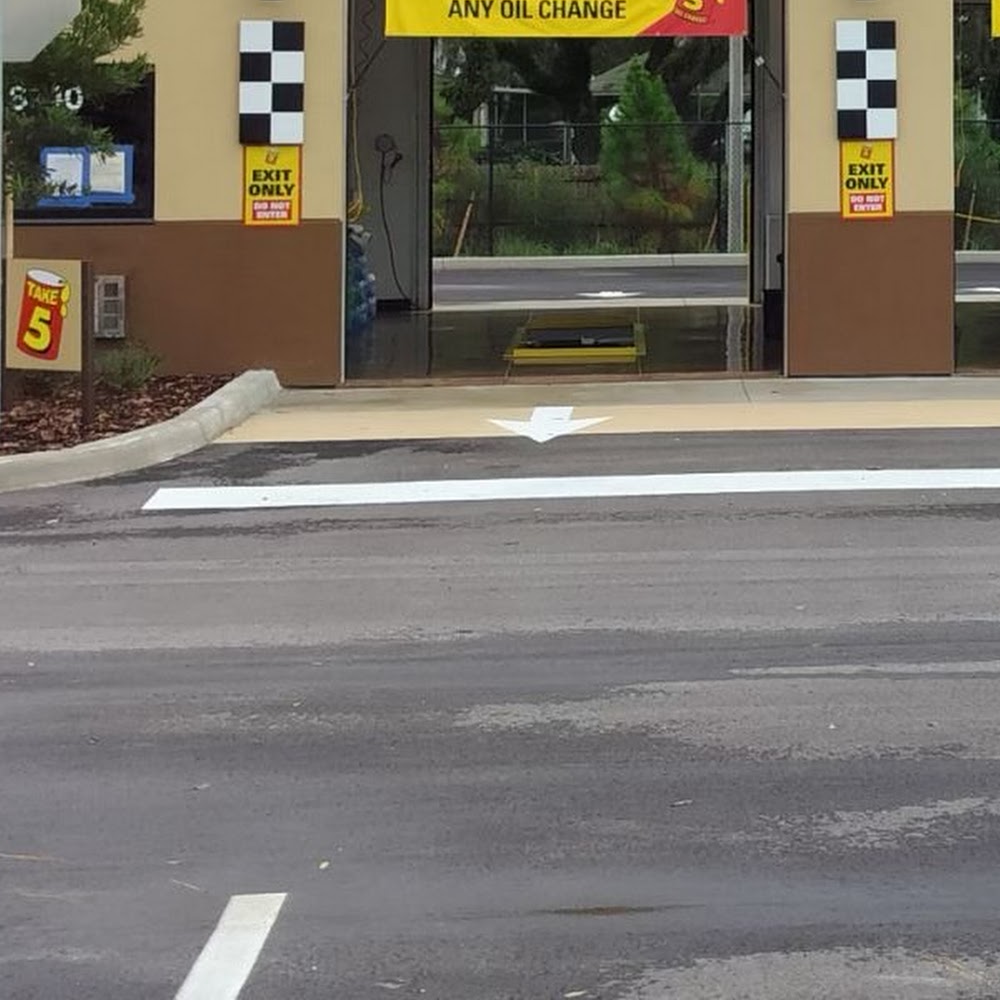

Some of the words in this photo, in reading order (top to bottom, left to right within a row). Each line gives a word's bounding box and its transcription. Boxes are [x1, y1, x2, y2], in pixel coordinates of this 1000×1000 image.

[447, 0, 495, 19] ANY
[500, 0, 533, 19] OIL
[538, 0, 627, 20] CHANGE
[252, 169, 292, 182] EXIT
[848, 163, 885, 176] EXIT
[845, 177, 888, 190] ONLY
[249, 184, 295, 197] ONLY
[26, 280, 60, 306] TAKE
[23, 305, 52, 353] 5
